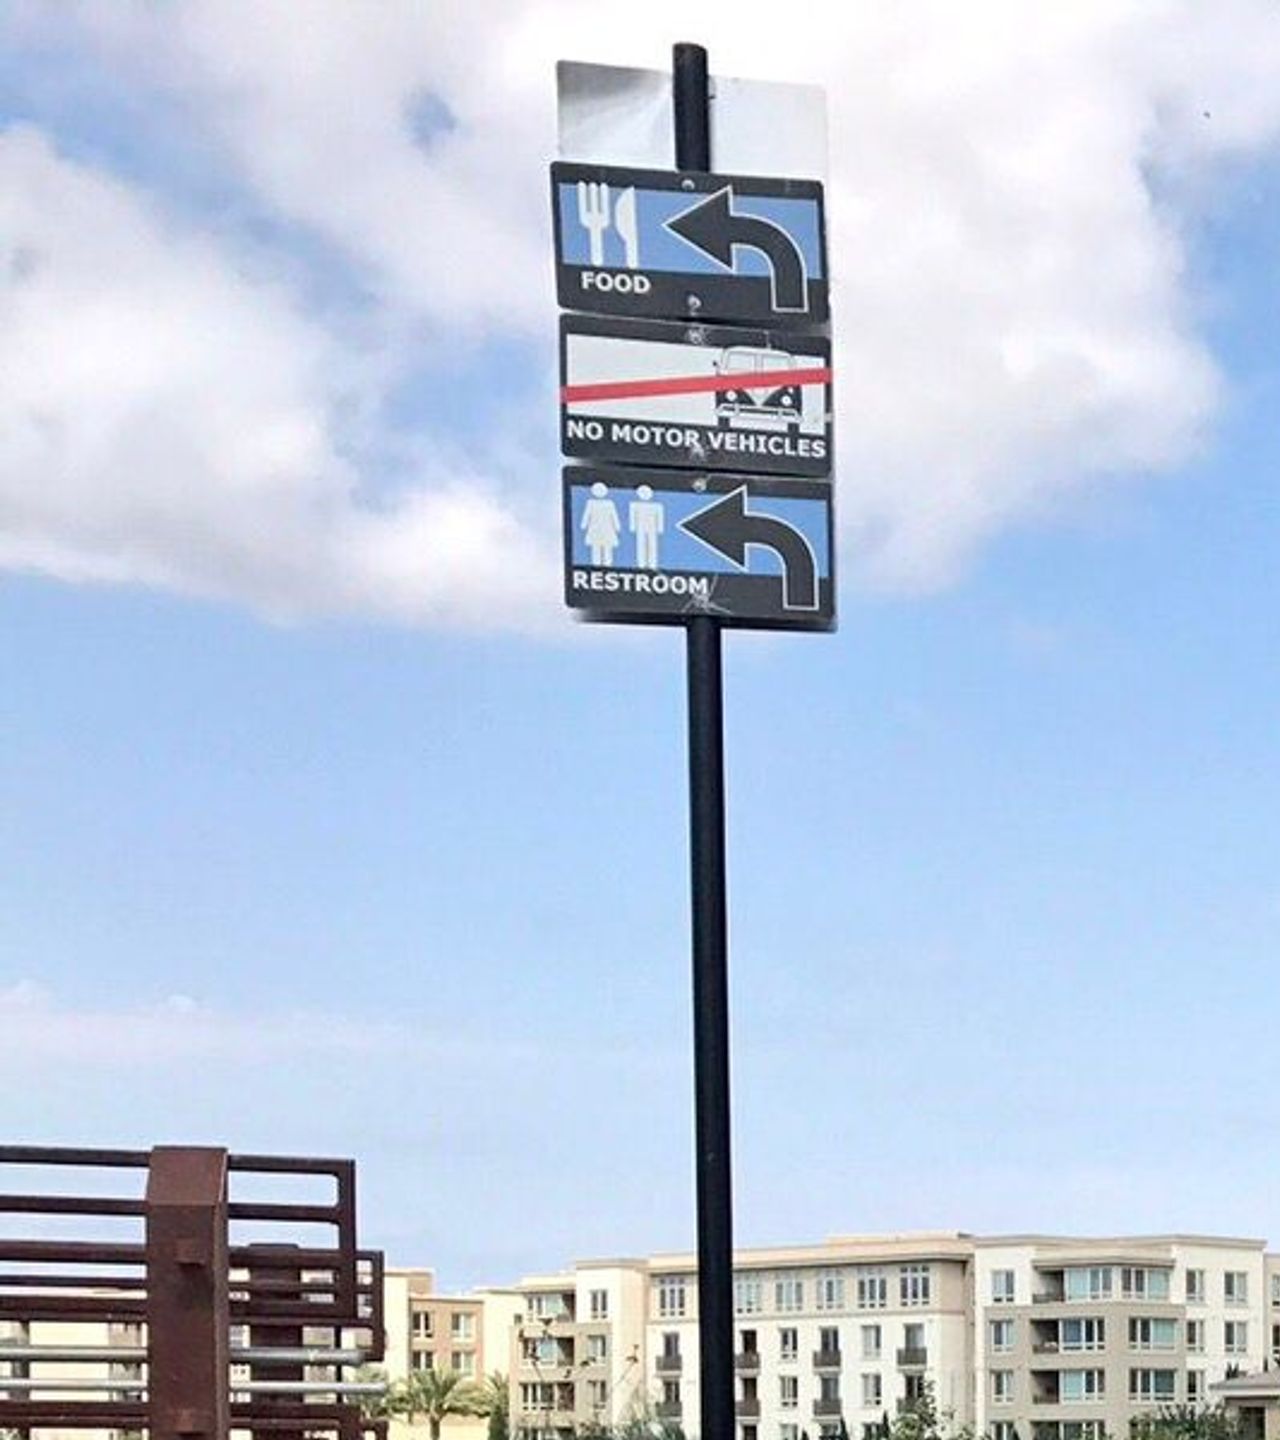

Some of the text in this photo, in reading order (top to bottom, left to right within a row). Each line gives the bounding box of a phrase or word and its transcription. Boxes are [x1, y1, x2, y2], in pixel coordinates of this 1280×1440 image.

[580, 269, 652, 296] FOOD
[566, 419, 827, 459] NO MOTOR VEHICLES
[571, 571, 710, 596] RESTROOM
